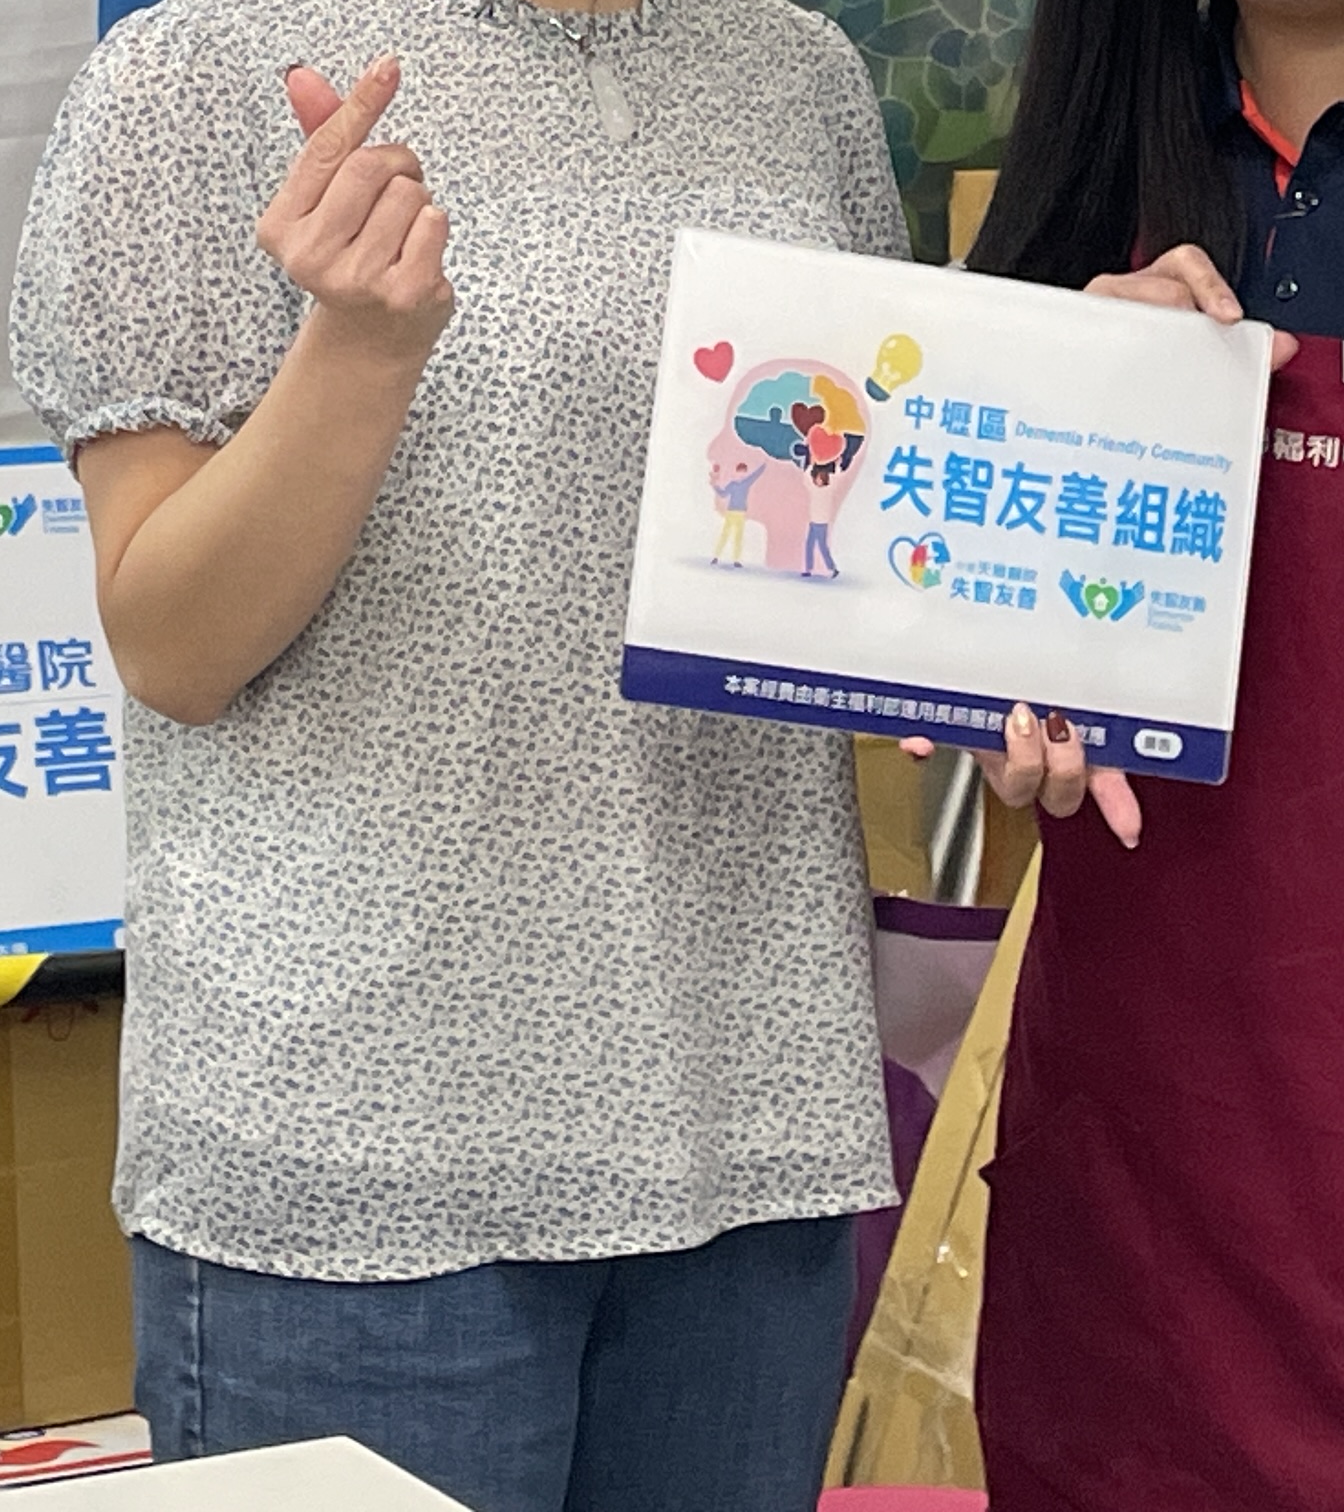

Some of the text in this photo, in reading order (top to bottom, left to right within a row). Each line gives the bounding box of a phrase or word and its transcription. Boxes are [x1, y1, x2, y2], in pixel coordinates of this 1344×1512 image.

[904, 394, 1233, 474] 中壢區 Dementia Friendly Community
[880, 445, 1228, 564] 失智友善組織
